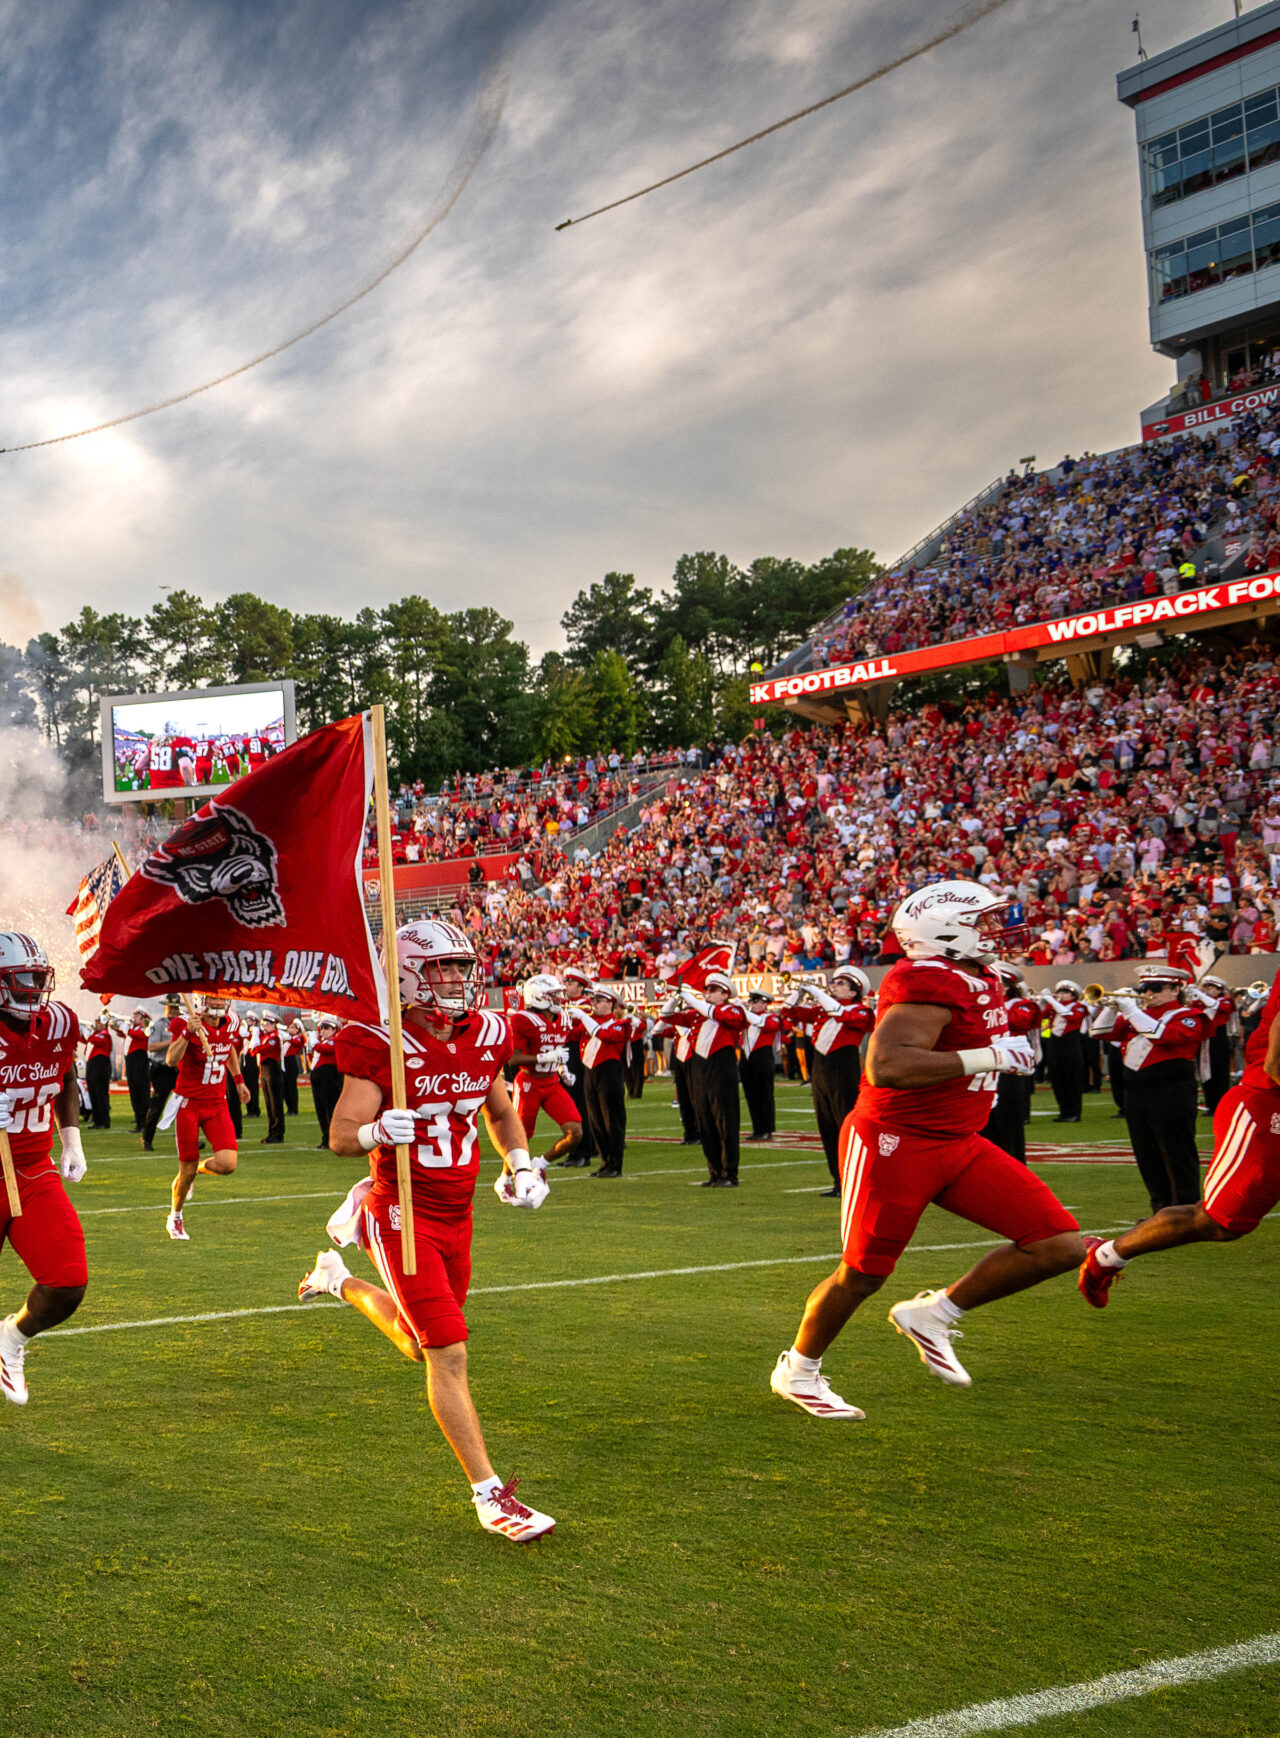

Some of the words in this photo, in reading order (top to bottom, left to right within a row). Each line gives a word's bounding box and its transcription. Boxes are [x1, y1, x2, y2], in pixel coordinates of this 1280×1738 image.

[1184, 407, 1226, 427] BILL
[1231, 389, 1280, 413] COW
[1047, 588, 1220, 641] WOLFPACK
[1228, 577, 1280, 604] FO
[774, 659, 897, 698] FOOTBALL
[151, 746, 173, 771] 58
[177, 844, 195, 856] NC
[195, 832, 226, 852] STATE
[910, 896, 934, 920] NC
[937, 891, 980, 906] State
[145, 953, 202, 985] ONE
[202, 950, 276, 989] PACK,
[280, 950, 324, 989] ONE
[612, 982, 646, 1001] YNE
[0, 1064, 27, 1084] NC
[29, 1062, 59, 1080] State
[202, 1054, 229, 1085] 15
[415, 1073, 449, 1096] NC
[451, 1071, 489, 1093] State
[416, 1096, 487, 1168] 37
